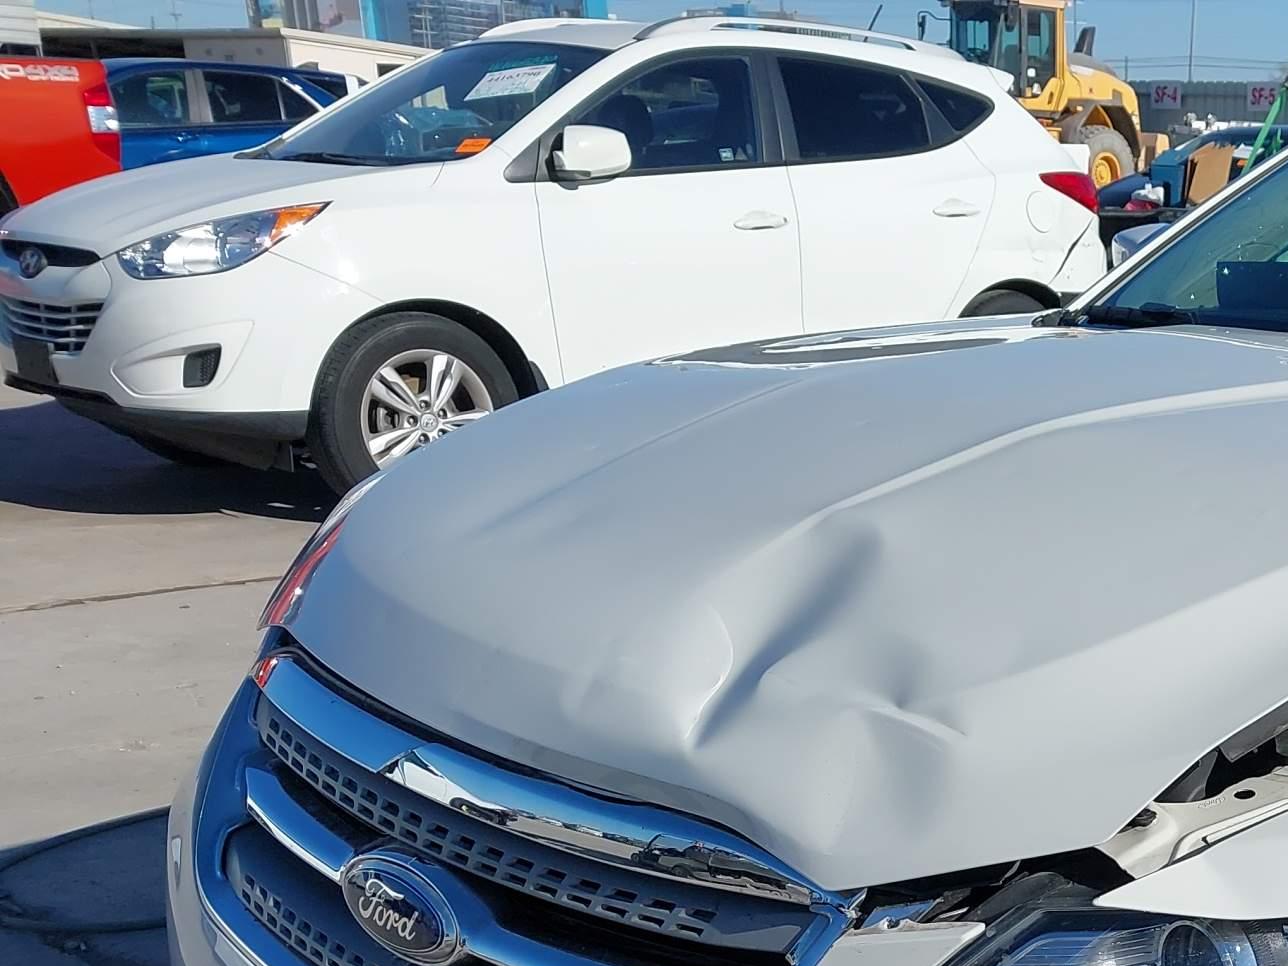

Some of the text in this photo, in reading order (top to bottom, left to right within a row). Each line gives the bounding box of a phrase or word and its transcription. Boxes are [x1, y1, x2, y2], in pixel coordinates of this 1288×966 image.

[1154, 86, 1178, 103] SF-4
[1251, 87, 1275, 105] SF-5
[358, 878, 419, 940] Ford
